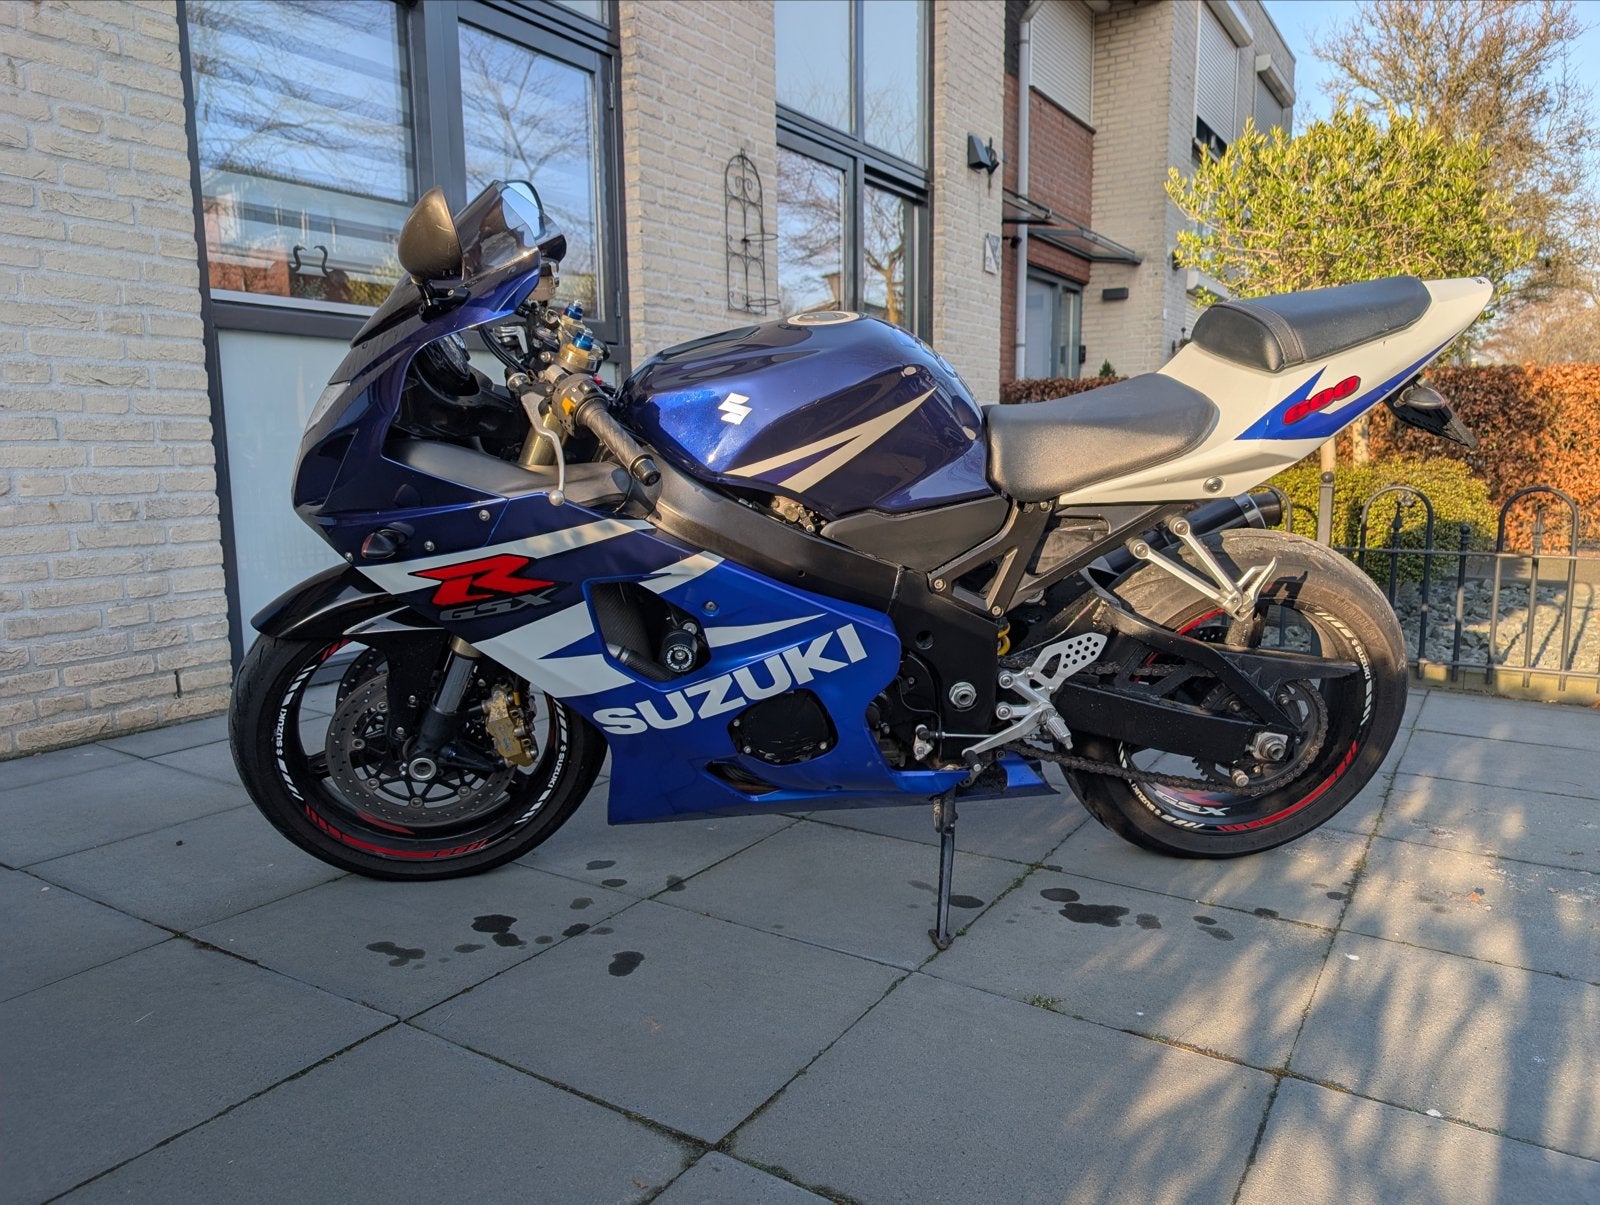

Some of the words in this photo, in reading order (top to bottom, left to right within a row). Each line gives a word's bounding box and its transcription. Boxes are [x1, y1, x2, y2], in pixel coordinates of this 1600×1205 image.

[1283, 375, 1361, 425] 600
[407, 553, 558, 607] R
[439, 586, 558, 621] GSX
[592, 622, 868, 736] SUZUKI
[1354, 645, 1371, 680] SUZUKI
[275, 708, 288, 748] SUZUKI
[547, 752, 565, 789] SUZUKI
[1153, 788, 1231, 816] GSX
